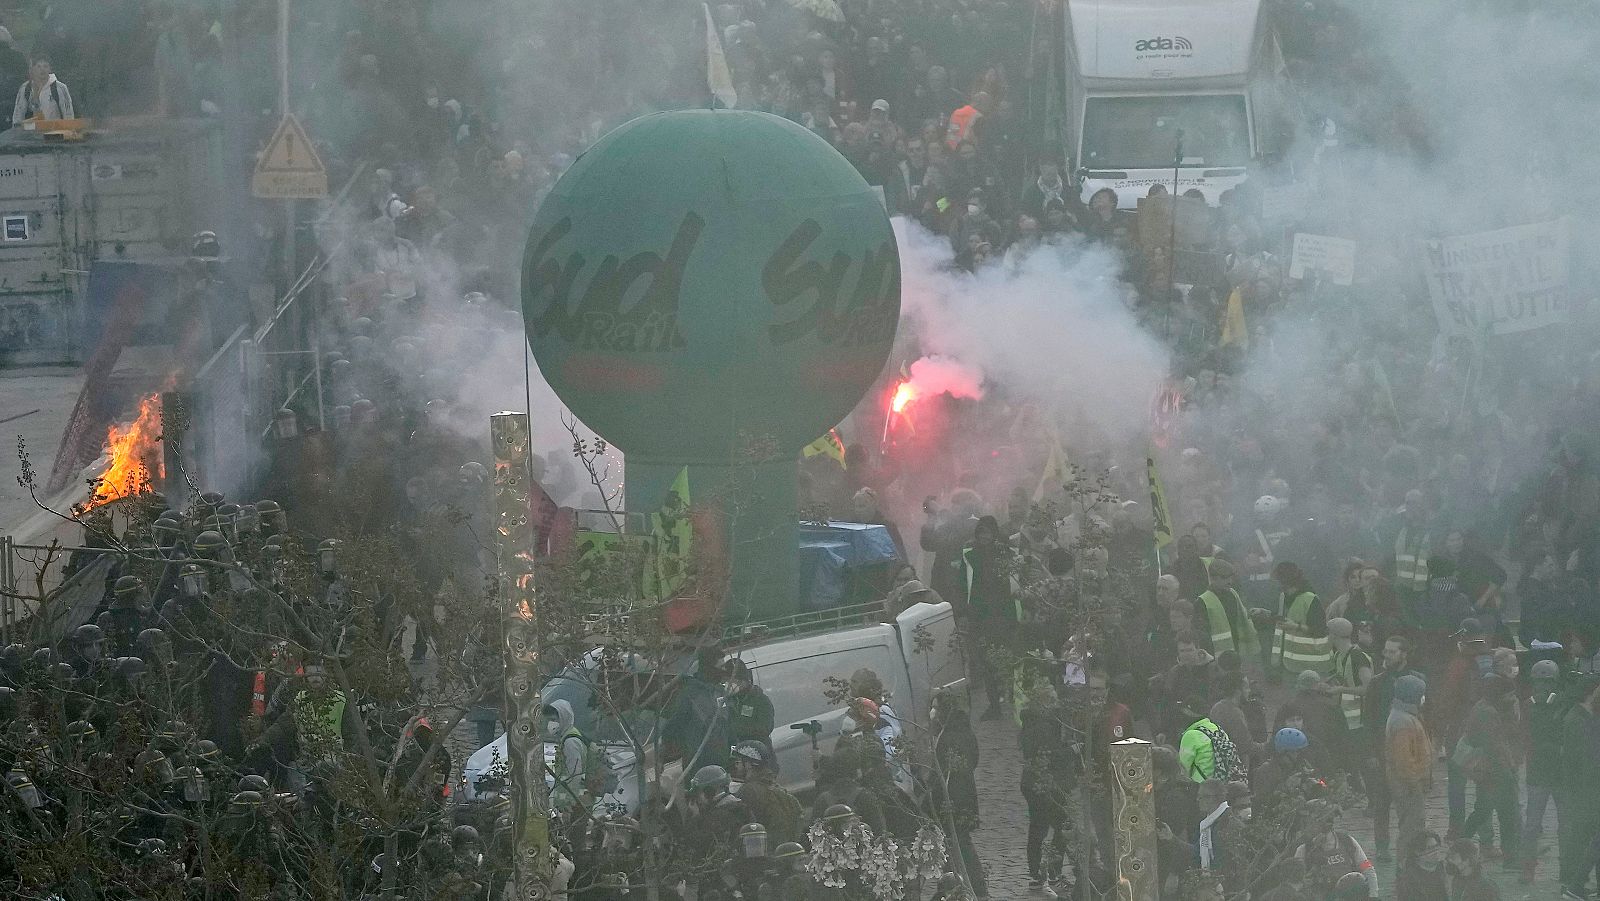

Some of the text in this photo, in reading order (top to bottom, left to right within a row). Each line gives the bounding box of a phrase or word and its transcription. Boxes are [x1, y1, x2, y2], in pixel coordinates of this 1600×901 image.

[1136, 36, 1173, 51] ada
[528, 210, 706, 342] Sud
[1433, 256, 1552, 298] TRAVAIL
[582, 311, 687, 352] Rail
